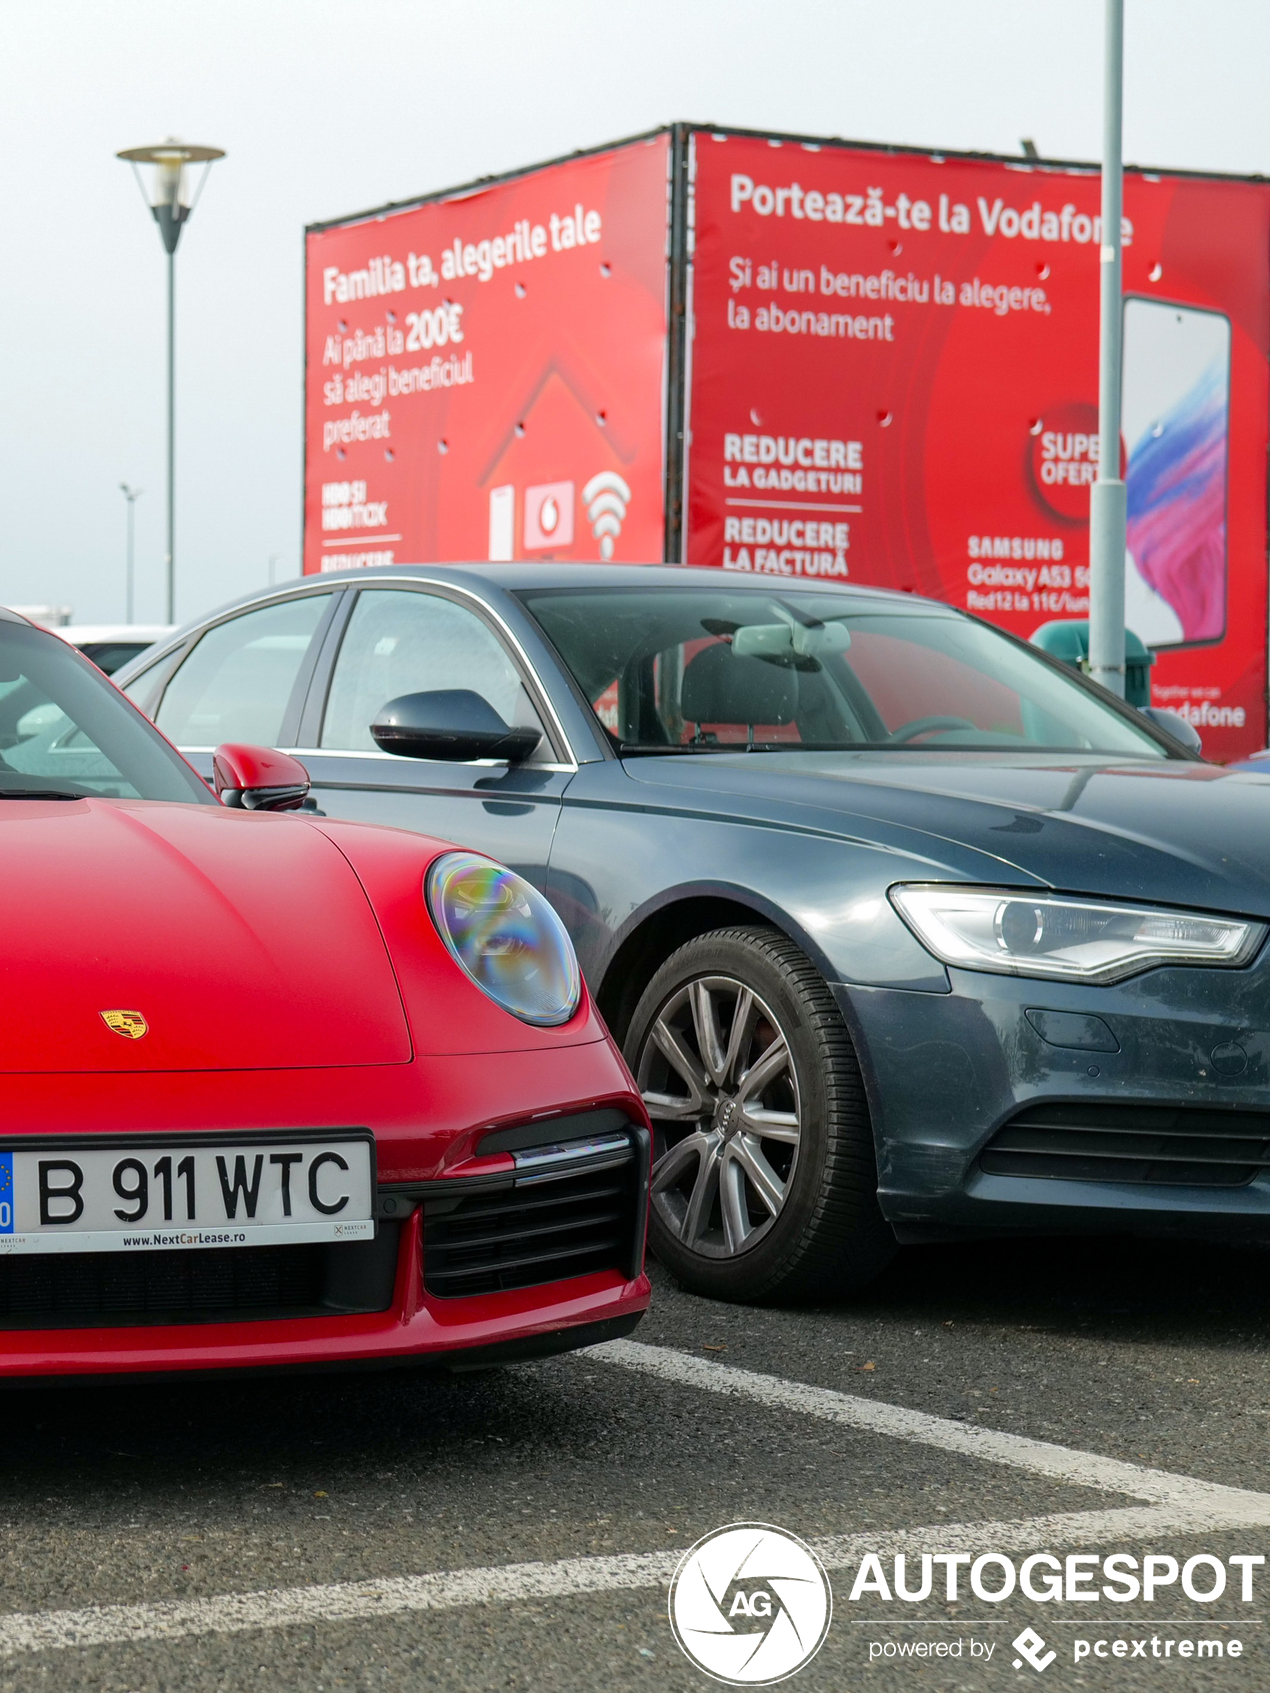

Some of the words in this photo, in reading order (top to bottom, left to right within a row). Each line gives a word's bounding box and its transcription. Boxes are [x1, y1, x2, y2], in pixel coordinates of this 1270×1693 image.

[731, 173, 932, 231] Portează-te
[939, 193, 970, 234] la
[323, 254, 406, 305] Familia
[408, 252, 438, 288] ta,
[441, 219, 547, 282] alegerile
[550, 203, 602, 252] tale
[756, 260, 778, 290] ai
[783, 267, 815, 293] un
[820, 264, 929, 303] beneficiu
[934, 274, 955, 305] la
[959, 276, 1051, 316] alegere,
[323, 334, 341, 366] Ai
[343, 326, 385, 370] până
[387, 324, 404, 355] la
[405, 302, 464, 352] 200€
[728, 298, 750, 330] la
[755, 301, 895, 342] abonament
[323, 373, 343, 406] să
[345, 367, 387, 406] alegi
[388, 350, 474, 396] beneficiul
[323, 408, 391, 452] preferat
[1041, 431, 1100, 460] SUPE
[724, 432, 863, 470] REDUCERE
[723, 465, 751, 488] LA
[752, 466, 863, 495] GADGETURI
[724, 516, 849, 549] REDUCERE
[967, 535, 1064, 561] SAMSUNG
[723, 546, 752, 571] LA
[754, 546, 849, 577] FACTURĂ
[967, 562, 1037, 592] Galaxy
[1038, 565, 1072, 588] A53
[1014, 591, 1030, 611] la
[1032, 590, 1090, 612] 11€/lun
[1154, 700, 1247, 727] dafone
[38, 1159, 84, 1225] B
[112, 1155, 196, 1223] 911
[216, 1151, 350, 1219] WTC
[123, 1232, 246, 1246] www.NextCarLease.ro
